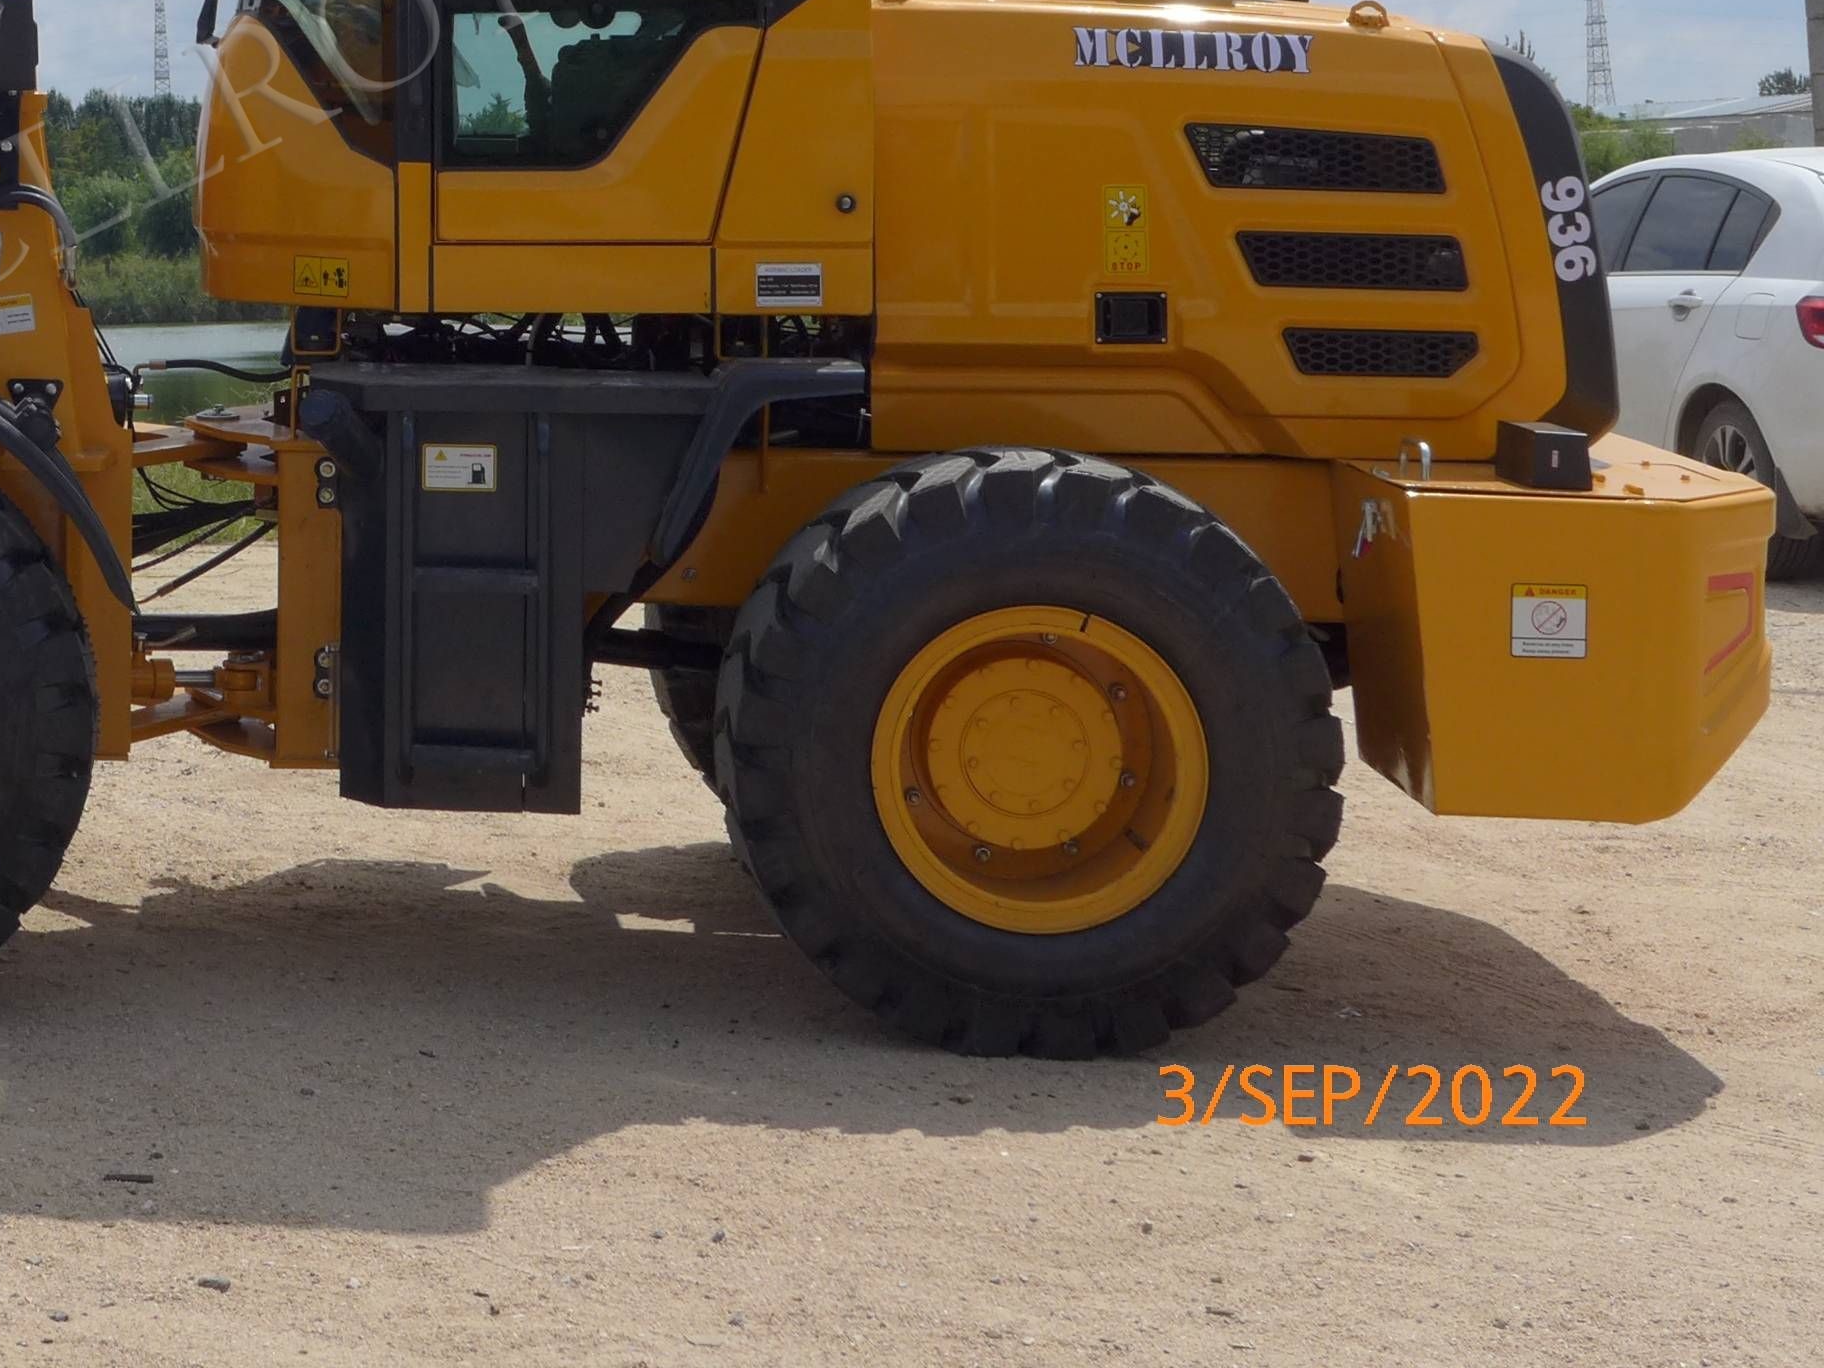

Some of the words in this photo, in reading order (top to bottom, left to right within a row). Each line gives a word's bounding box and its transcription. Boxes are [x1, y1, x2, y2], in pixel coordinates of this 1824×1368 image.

[1073, 26, 1313, 73] MCLLROY
[1541, 176, 1596, 282] 936
[1111, 262, 1141, 271] STOP
[1539, 587, 1576, 595] DANGER
